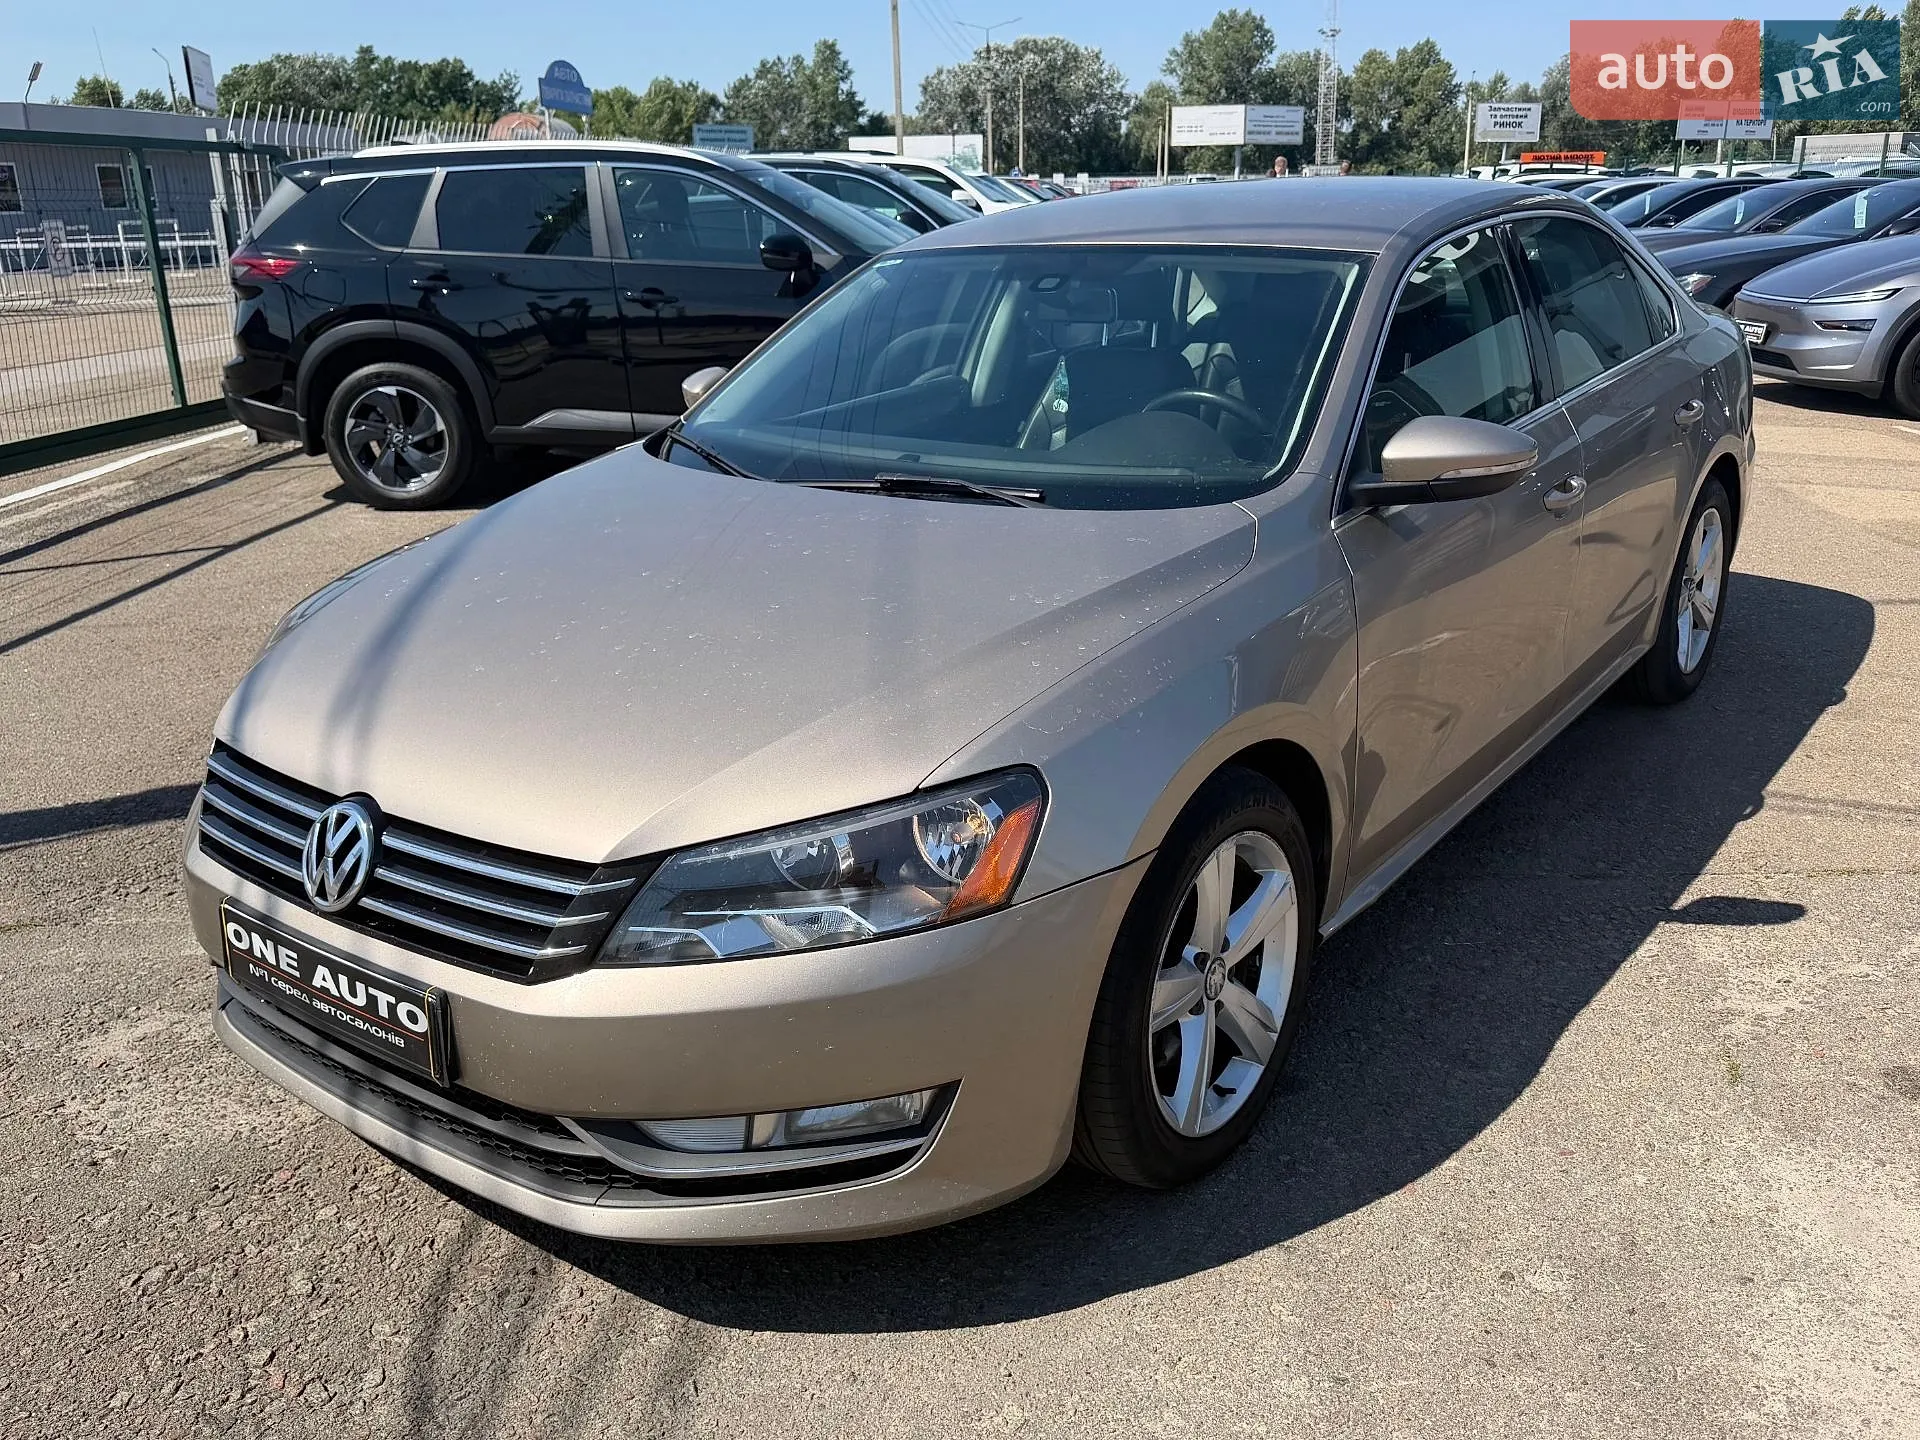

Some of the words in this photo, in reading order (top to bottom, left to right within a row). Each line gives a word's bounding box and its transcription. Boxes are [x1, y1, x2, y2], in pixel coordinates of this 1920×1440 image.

[1493, 120, 1523, 129] РИНОК
[227, 921, 300, 978] ONE
[312, 964, 428, 1033] AUTO
[271, 976, 310, 1004] серед
[312, 999, 405, 1048] автосалонів
